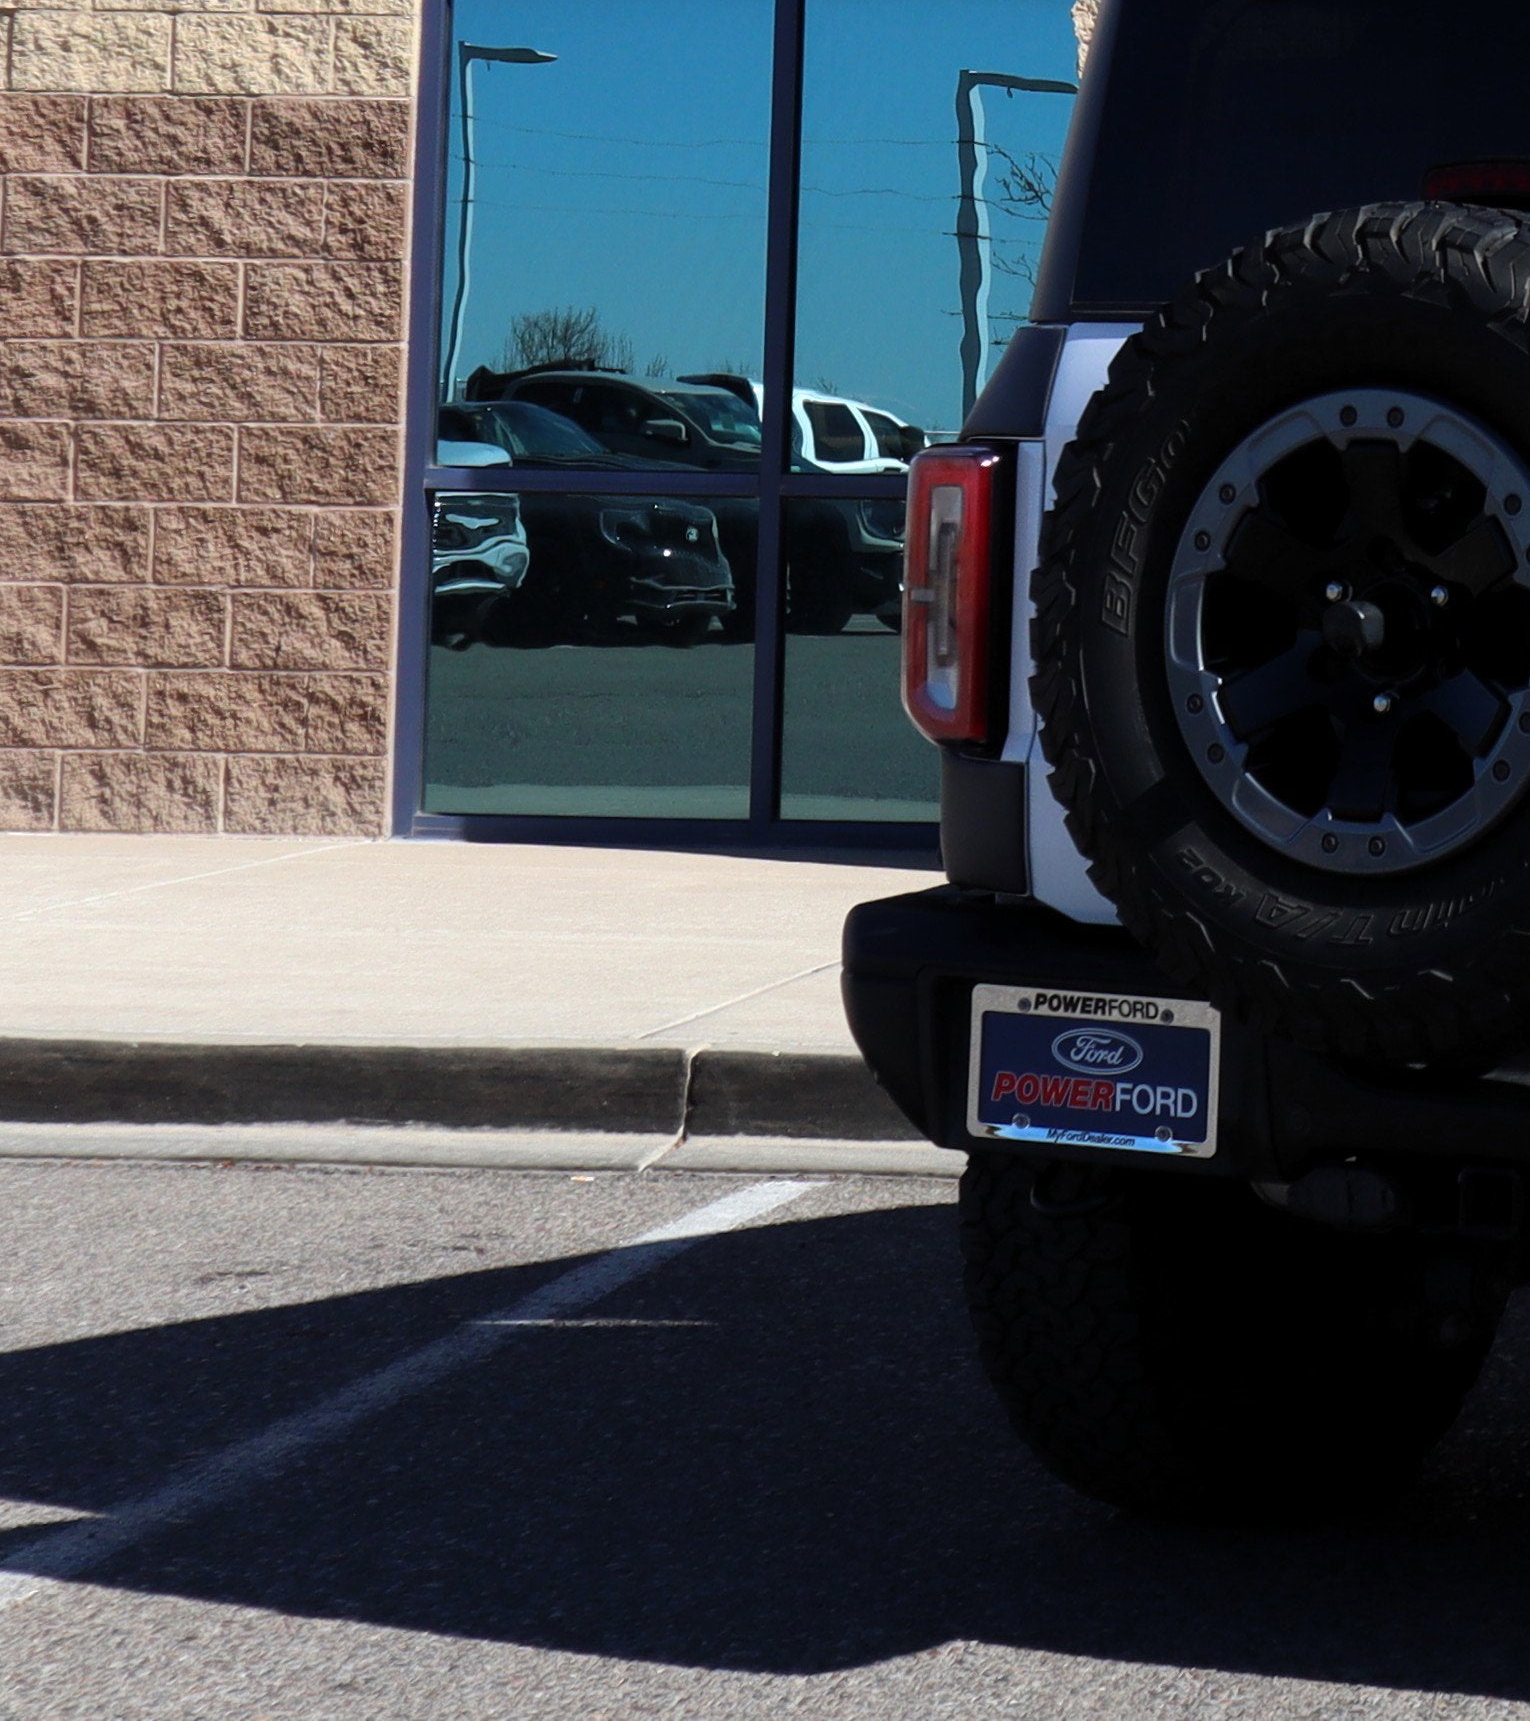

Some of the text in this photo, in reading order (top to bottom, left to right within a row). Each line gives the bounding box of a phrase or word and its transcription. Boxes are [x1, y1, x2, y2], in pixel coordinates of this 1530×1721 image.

[1033, 993, 1159, 1020] POWERFORD
[1070, 1035, 1123, 1065] Ford
[991, 1072, 1197, 1118] POWERFORD
